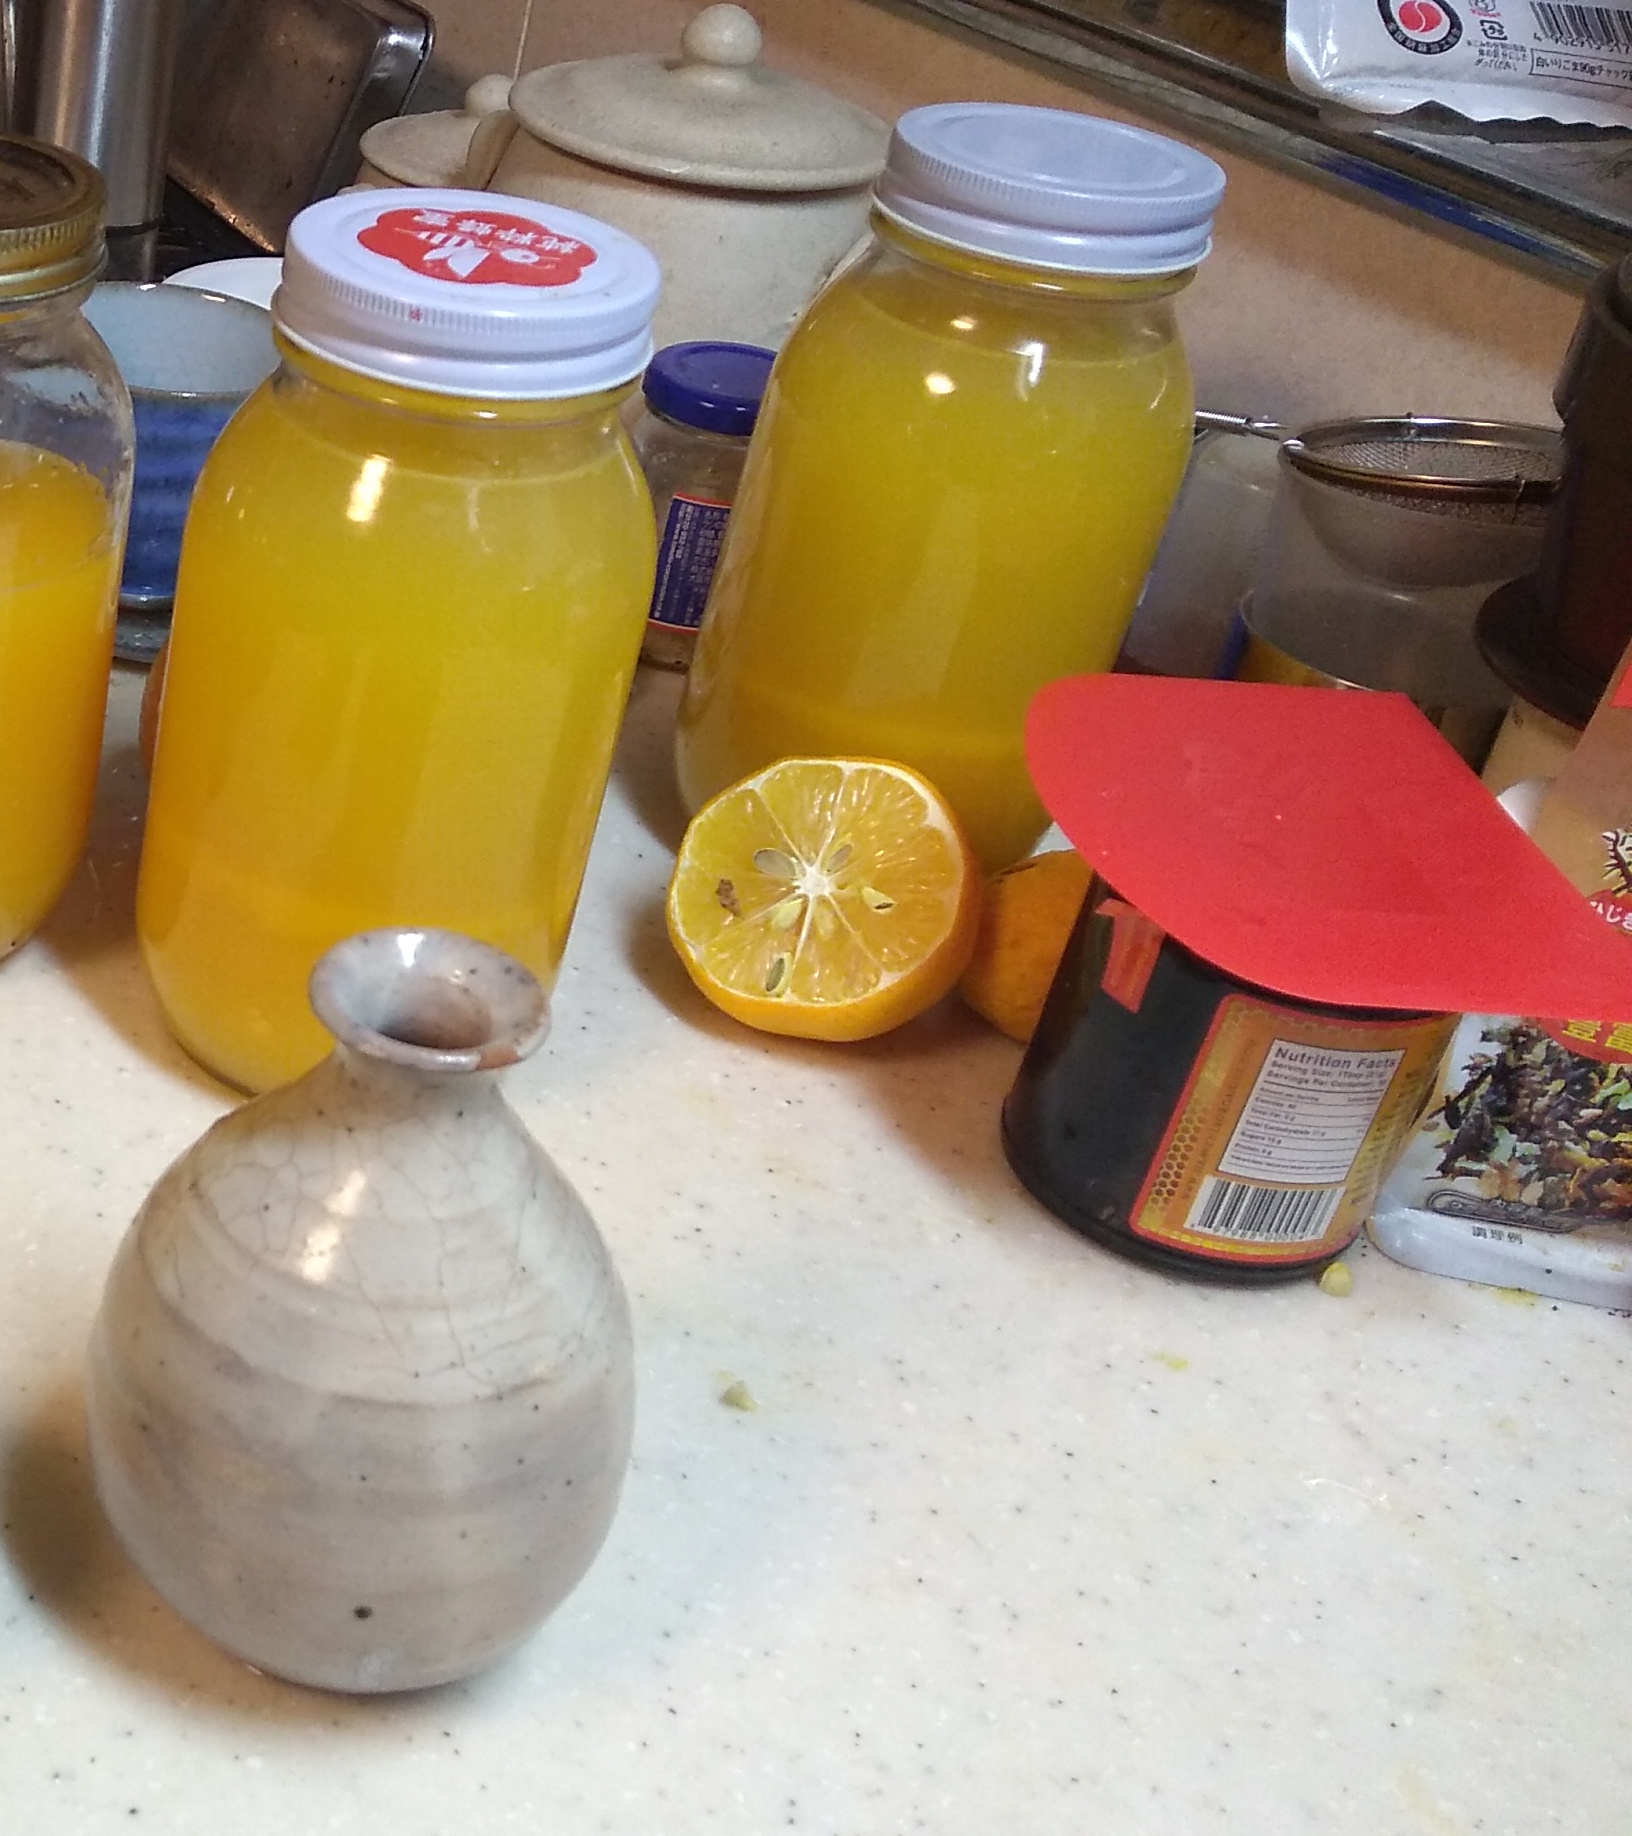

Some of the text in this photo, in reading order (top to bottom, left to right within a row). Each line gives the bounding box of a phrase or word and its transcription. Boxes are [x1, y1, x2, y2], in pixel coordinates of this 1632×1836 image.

[1271, 1059, 1309, 1075] Serving
[1274, 1046, 1396, 1069] Nutrition Facts
[1267, 1069, 1309, 1085] Servings
[1471, 1224, 1524, 1246] 調理例
